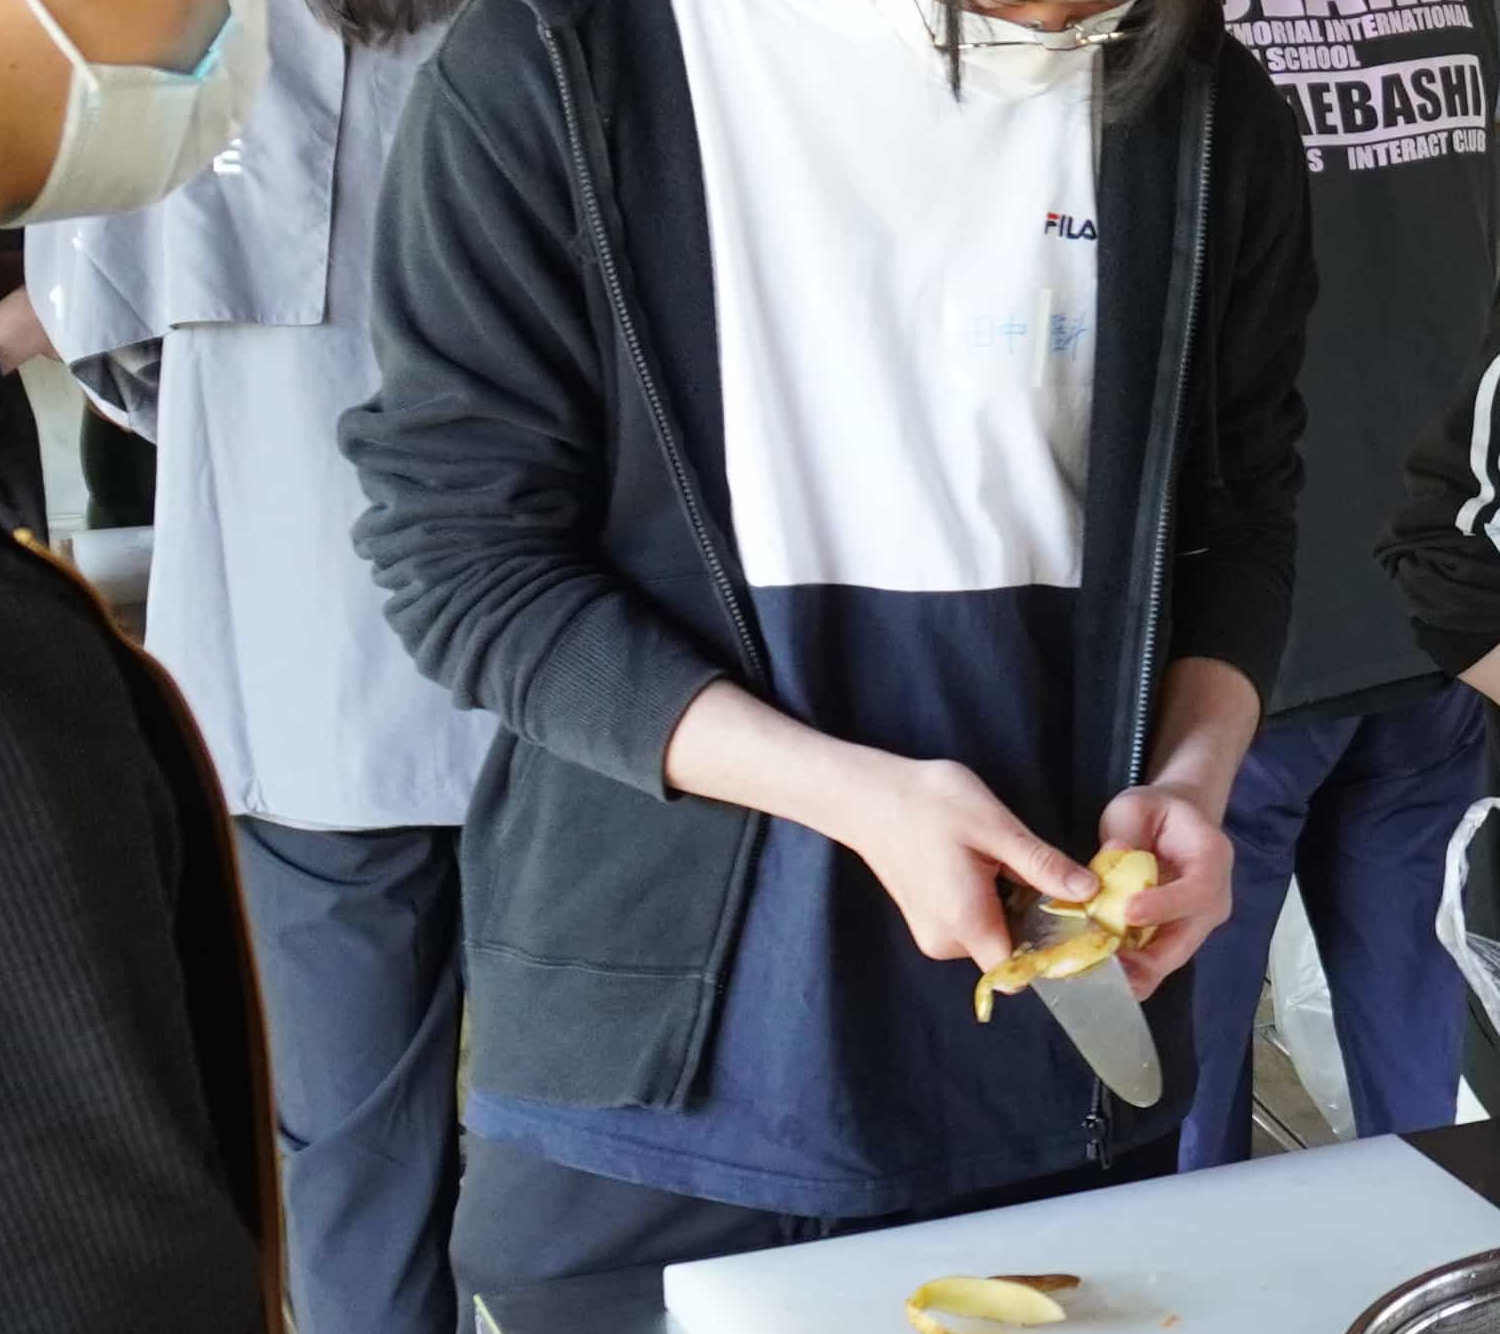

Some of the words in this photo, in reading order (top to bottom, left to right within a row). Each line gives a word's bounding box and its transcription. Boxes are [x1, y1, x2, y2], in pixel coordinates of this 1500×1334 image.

[1225, 20, 1323, 45] MORIAL
[1324, 5, 1473, 44] INTERNATIONAL
[1266, 44, 1361, 71] SCHOOL
[1348, 132, 1448, 170] INTERACT
[1452, 128, 1487, 155] CLUB
[1044, 212, 1097, 240] FILA
